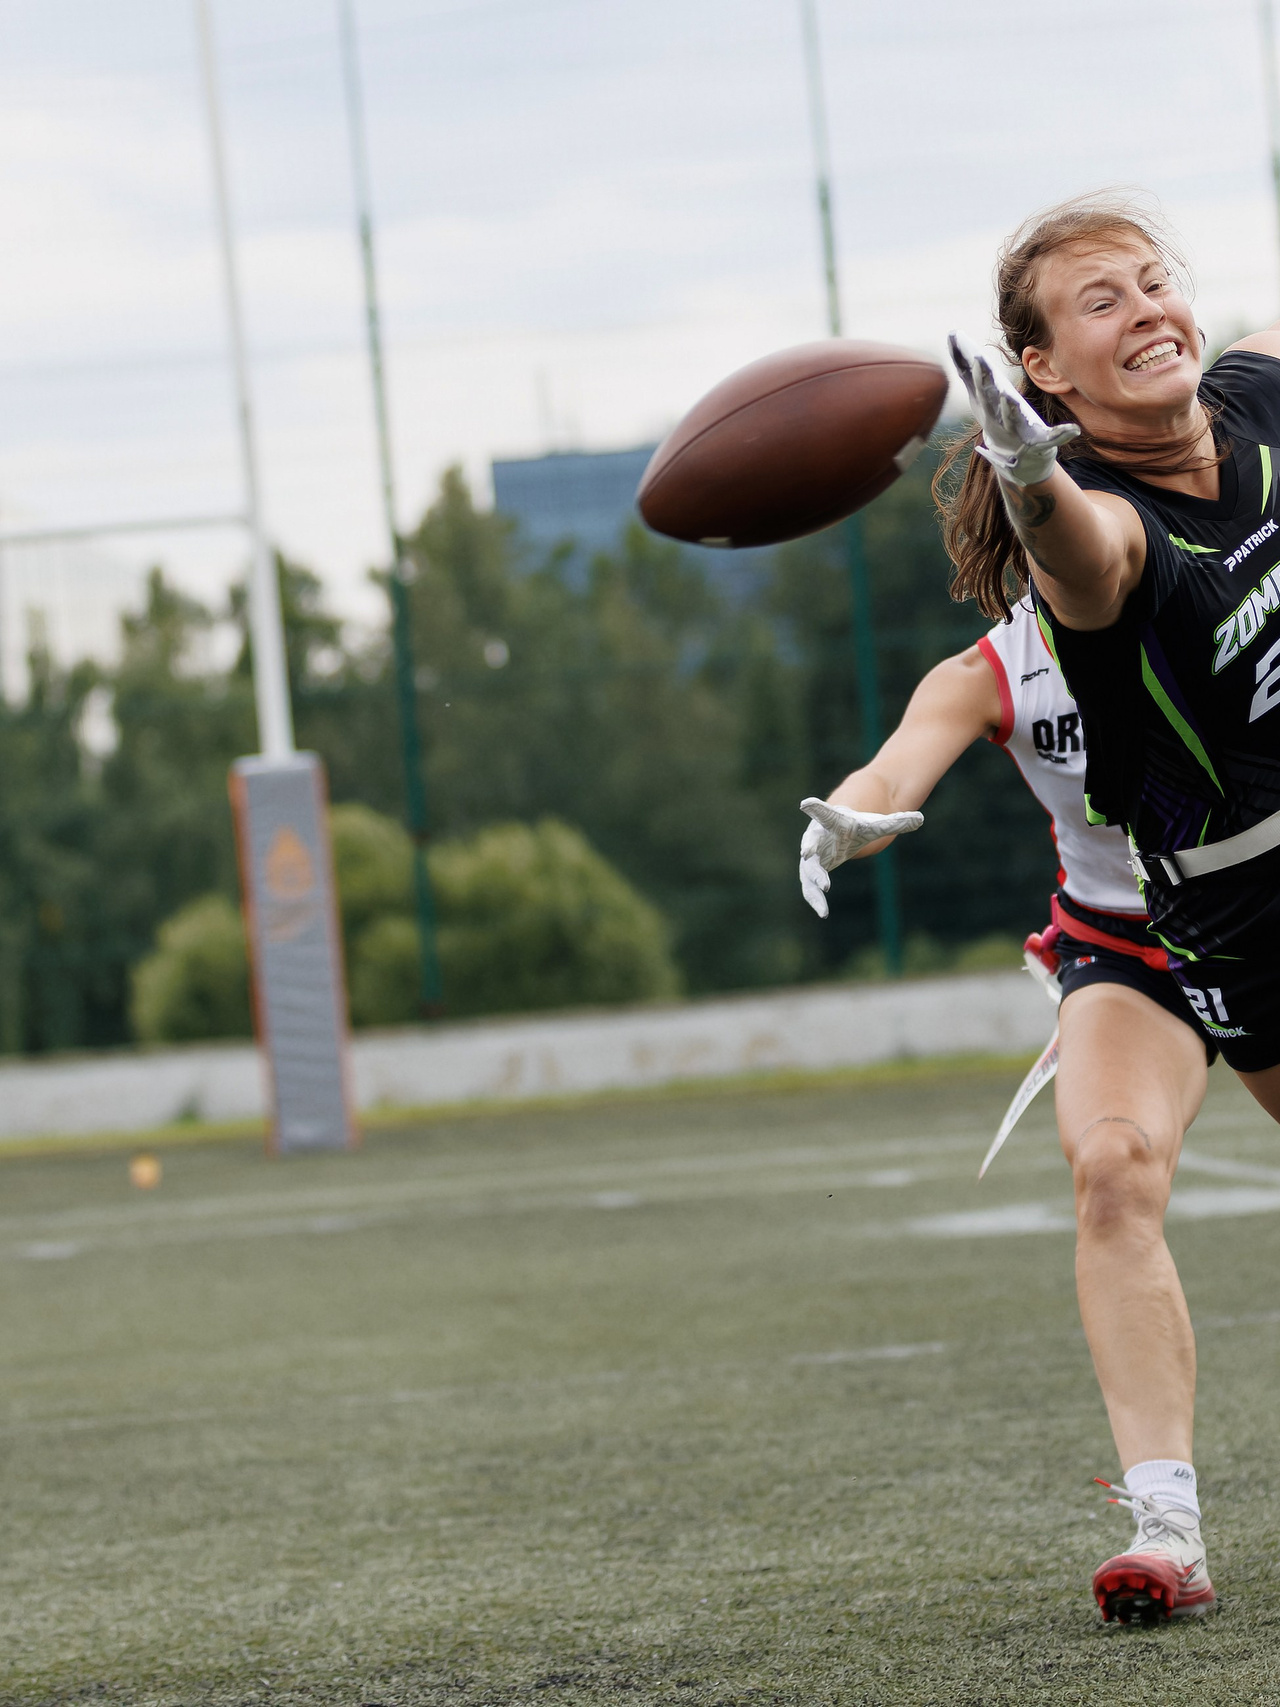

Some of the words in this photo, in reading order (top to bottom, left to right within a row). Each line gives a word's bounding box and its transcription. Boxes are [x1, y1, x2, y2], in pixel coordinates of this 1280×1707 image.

[1234, 518, 1279, 563] PATRICK
[1182, 986, 1230, 1022] 21
[1203, 1022, 1247, 1038] ATRICK
